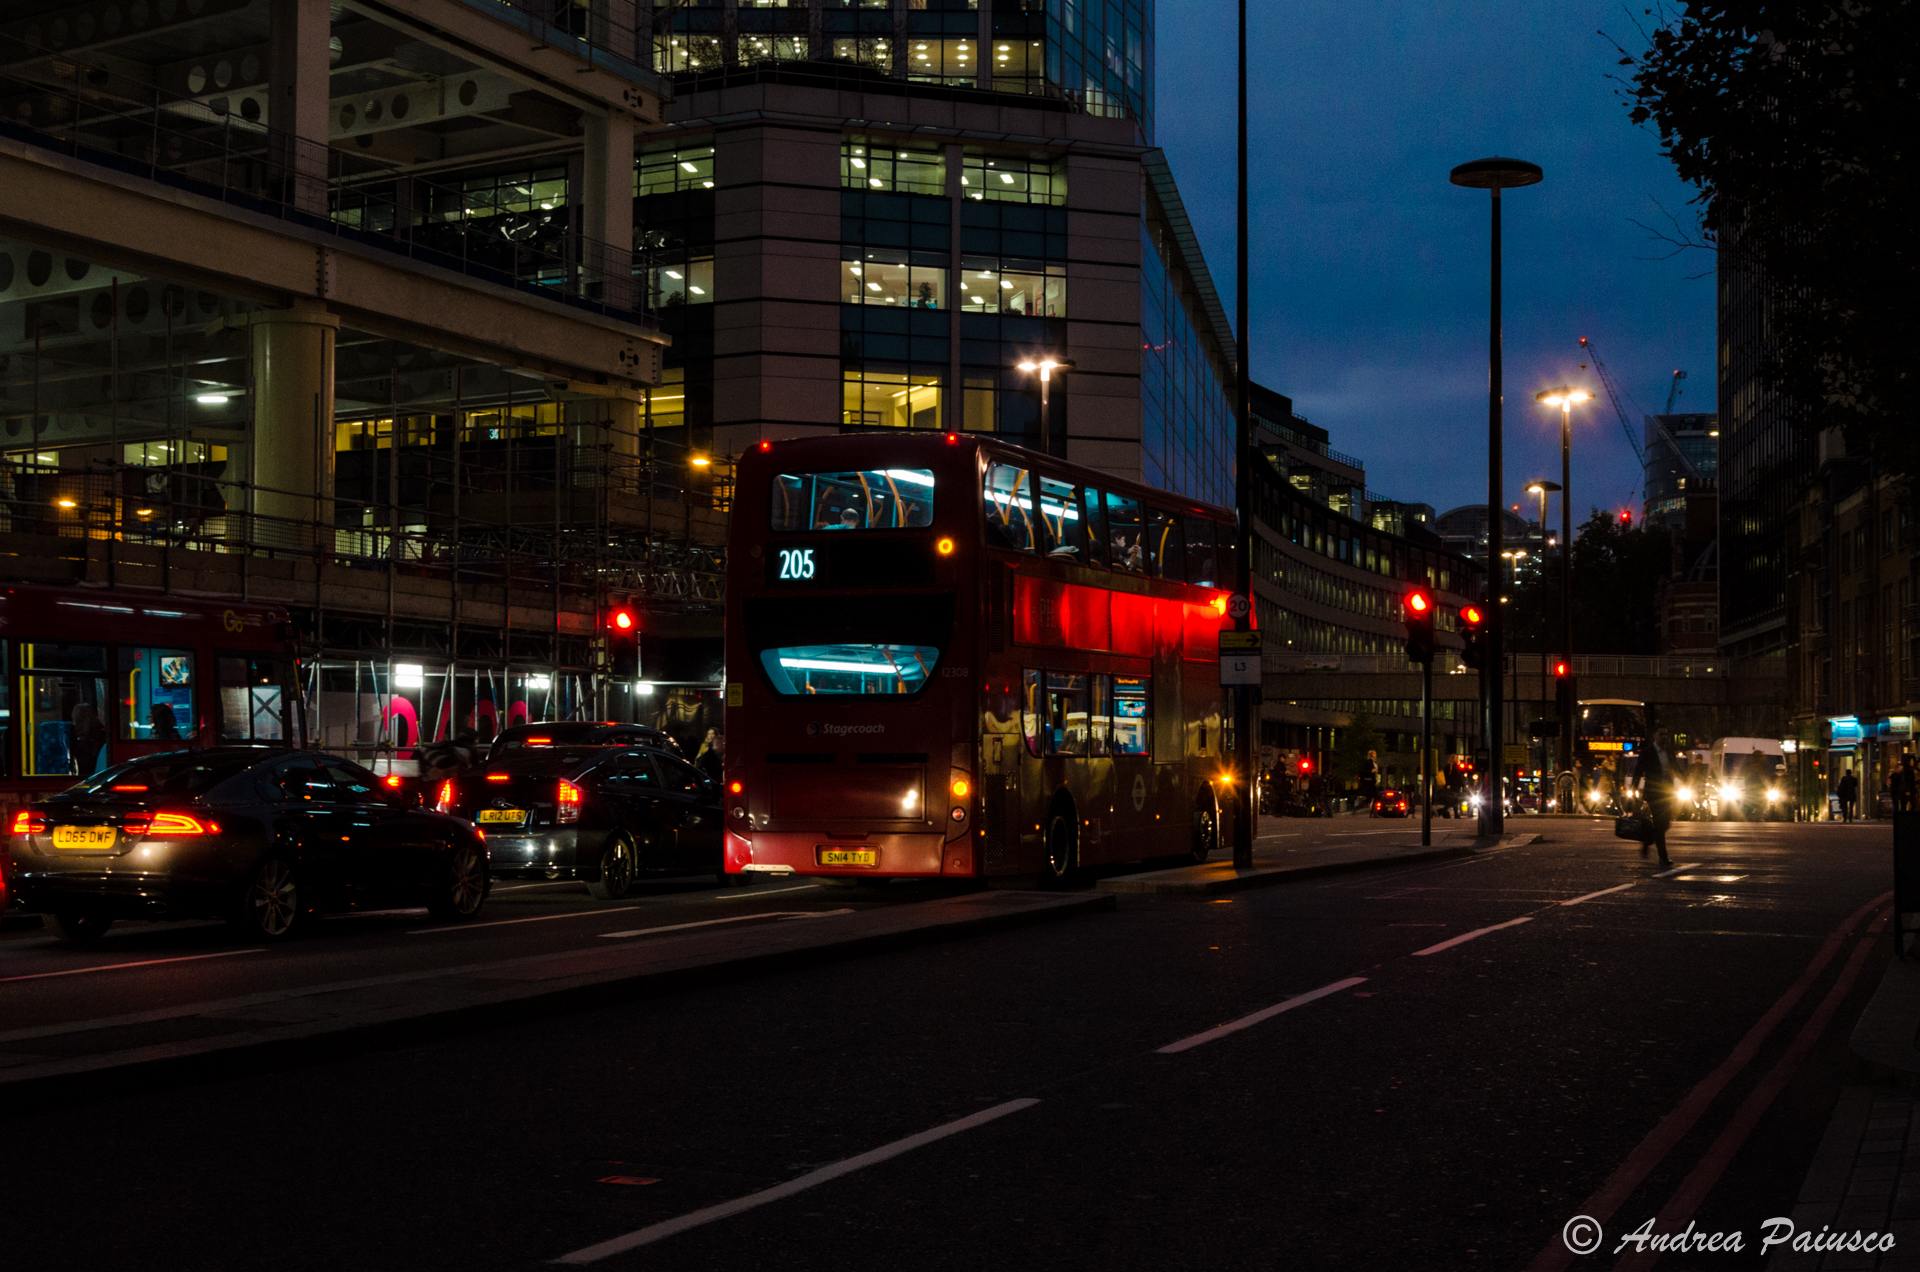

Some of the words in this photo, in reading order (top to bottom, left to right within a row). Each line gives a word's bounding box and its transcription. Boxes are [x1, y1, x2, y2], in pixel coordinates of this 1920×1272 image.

[779, 549, 815, 579] 205
[1229, 600, 1247, 612] 20
[223, 609, 243, 633] Go
[942, 667, 969, 678] 12308
[1234, 662, 1246, 672] L3
[822, 723, 885, 737] Stagecoach
[483, 811, 503, 821] LR12
[58, 831, 86, 843] LD65
[89, 831, 111, 843] DWF
[828, 852, 848, 862] SN14
[851, 852, 870, 862] TYD
